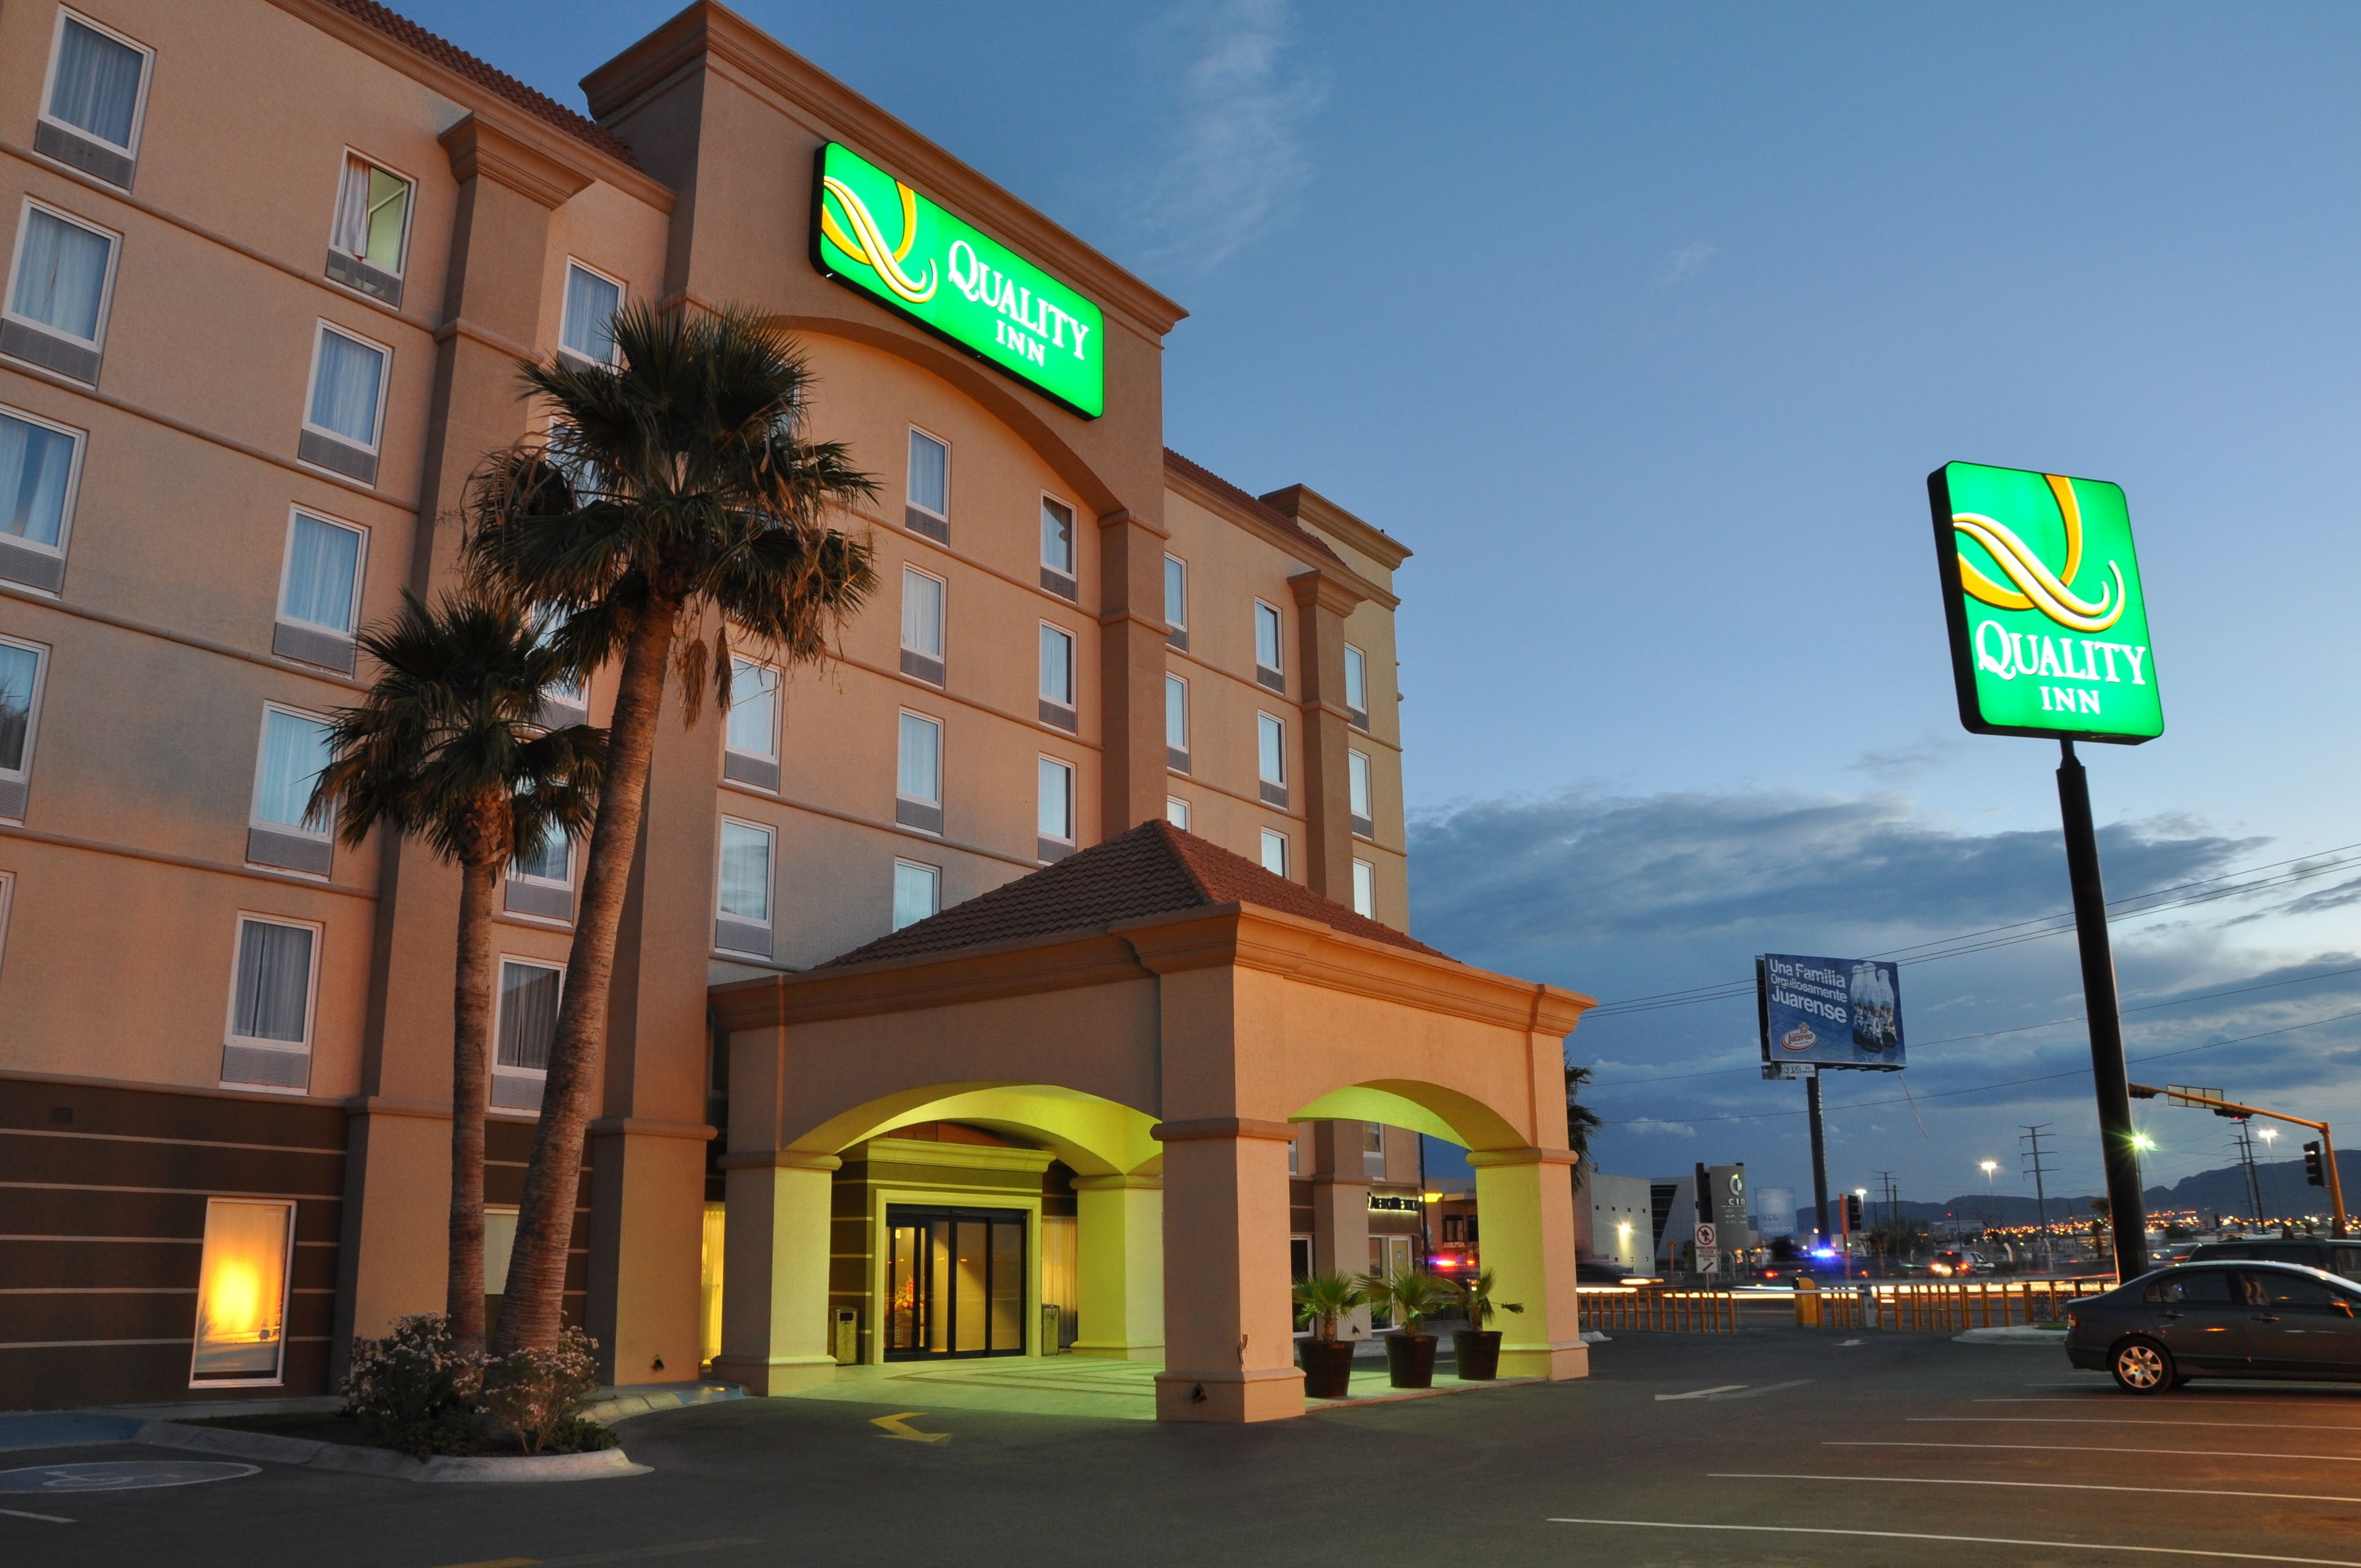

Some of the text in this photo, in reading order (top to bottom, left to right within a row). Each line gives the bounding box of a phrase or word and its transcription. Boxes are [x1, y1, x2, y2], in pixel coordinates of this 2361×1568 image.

[948, 240, 1090, 360] QUALITY
[995, 319, 1045, 367] INN
[1975, 619, 2146, 685] QUALITY
[2038, 686, 2101, 715] INN
[1770, 959, 1846, 989] Una Familia
[1770, 973, 1848, 1003] Orgullosamente
[1771, 985, 1847, 1024] Juarense
